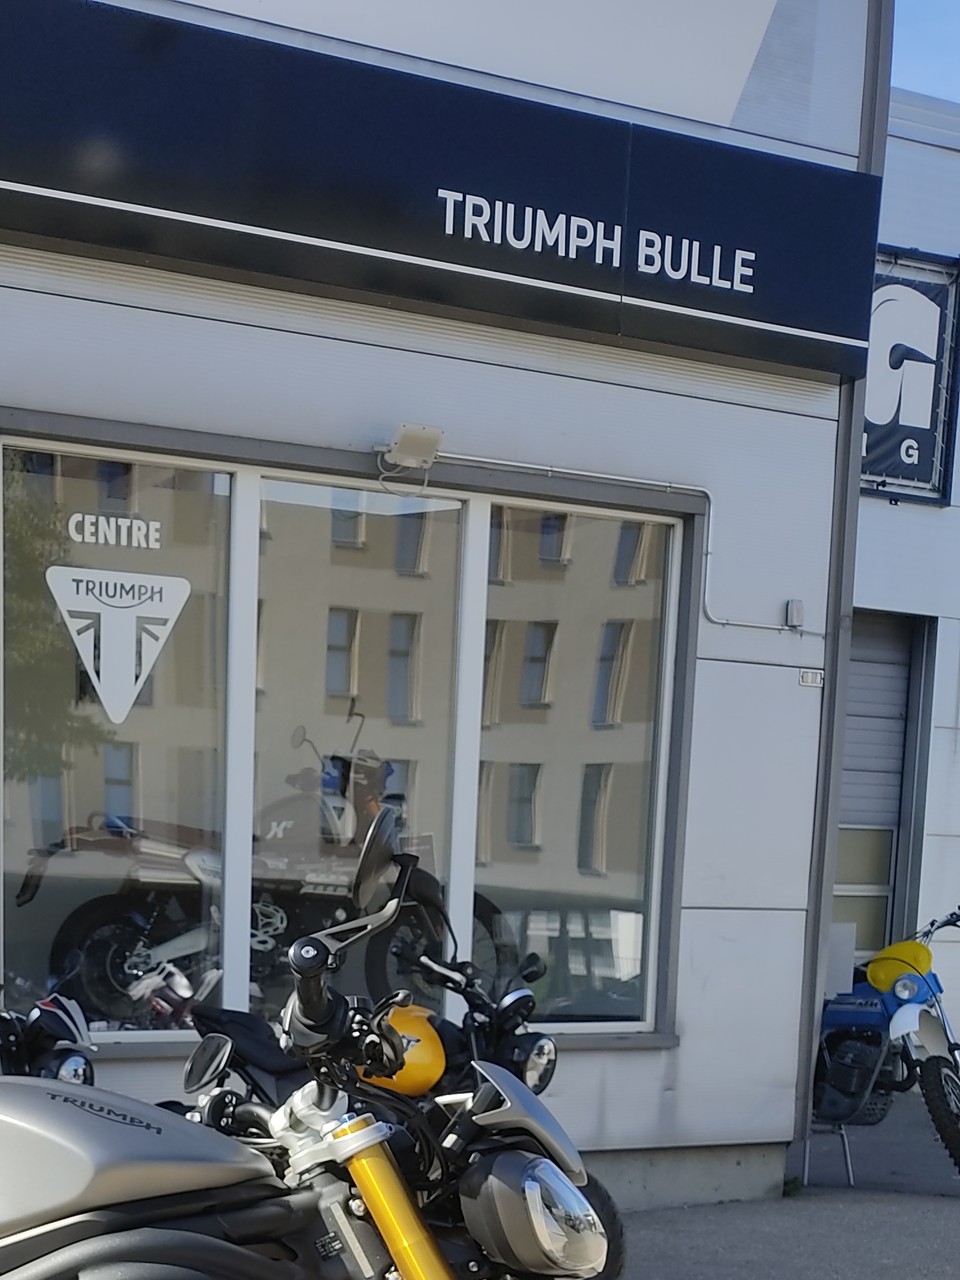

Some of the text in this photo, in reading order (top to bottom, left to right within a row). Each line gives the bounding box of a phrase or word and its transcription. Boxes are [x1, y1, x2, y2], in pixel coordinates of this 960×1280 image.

[438, 188, 756, 294] TRIUMPH BULLE
[68, 513, 161, 549] CENTRE
[72, 578, 163, 603] TRIUMPH
[46, 1092, 162, 1135] TRIUMPH
